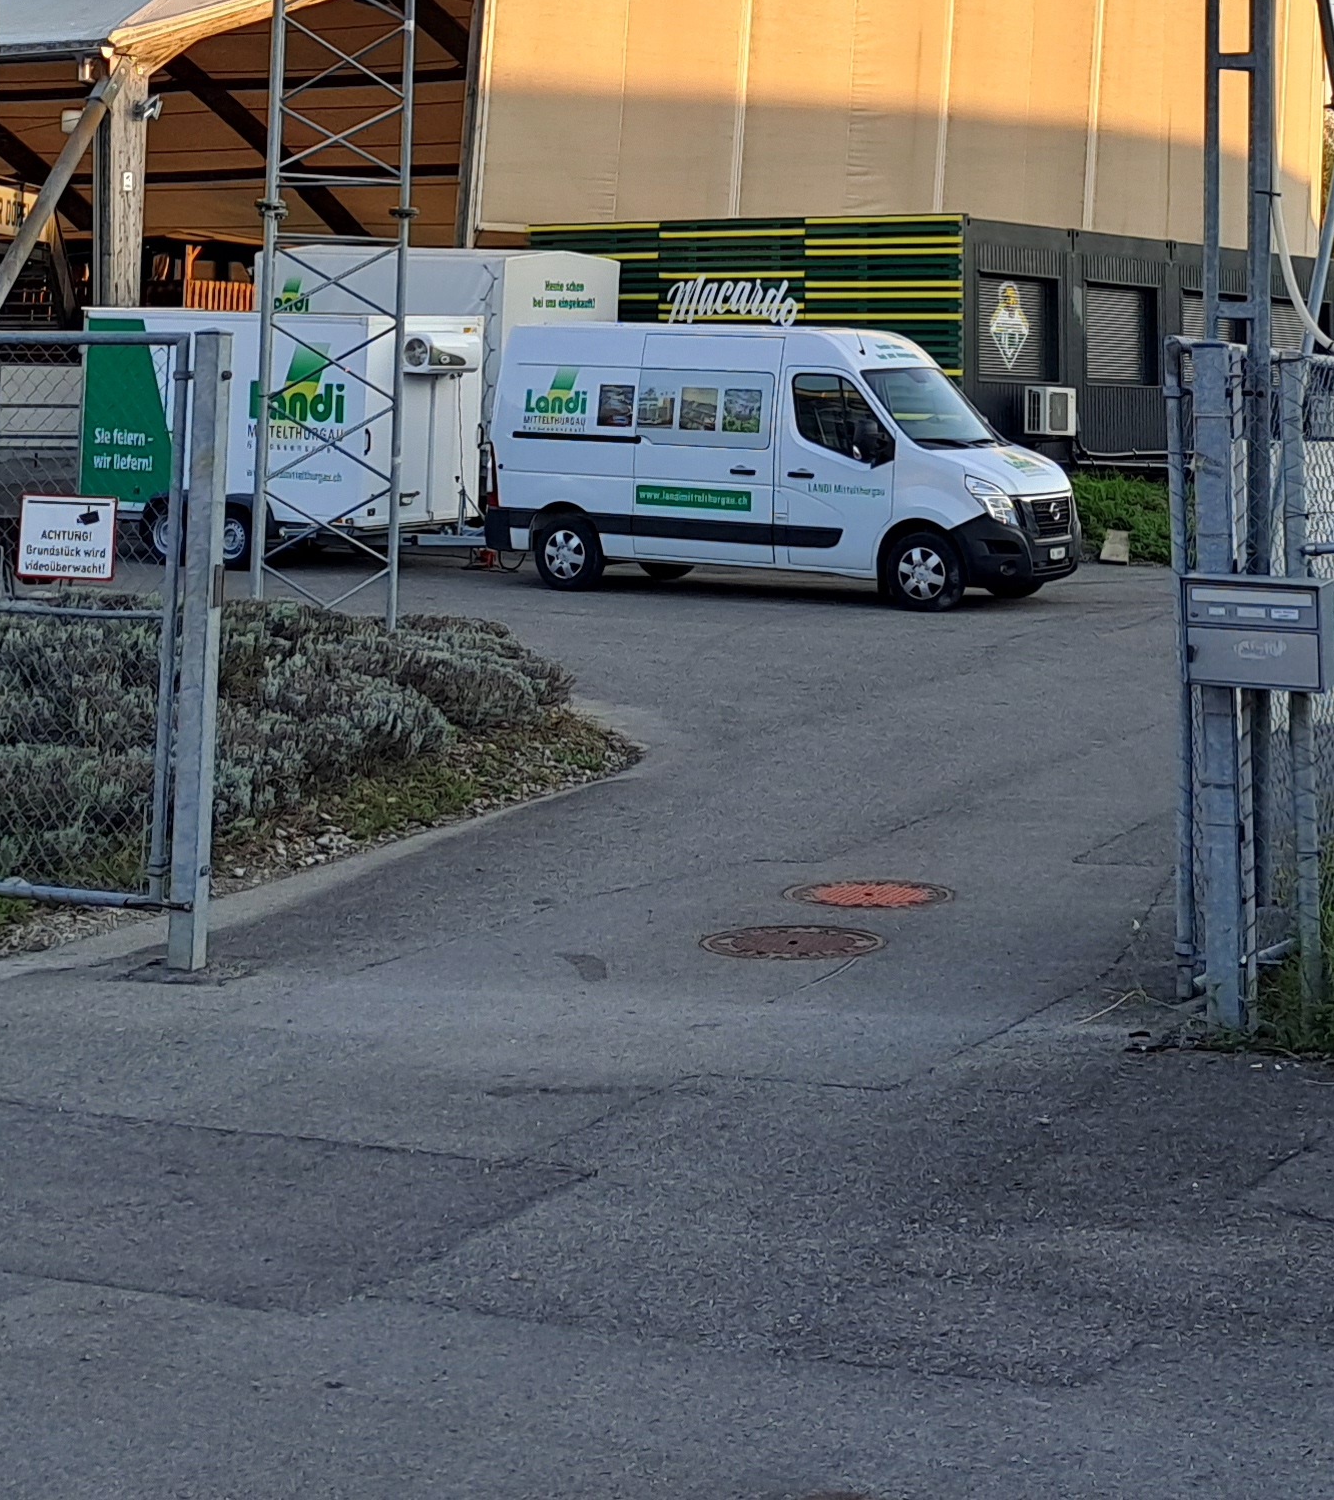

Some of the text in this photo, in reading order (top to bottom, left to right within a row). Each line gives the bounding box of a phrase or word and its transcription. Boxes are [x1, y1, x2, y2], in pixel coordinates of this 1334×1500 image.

[274, 293, 309, 312] andi
[667, 275, 798, 327] Macardo
[524, 389, 588, 415] Landi
[94, 427, 111, 444] Sie
[113, 427, 146, 447] feiern
[247, 424, 344, 442] MTELTHURGAU
[93, 452, 153, 472] wir liefern!
[808, 483, 831, 494] LANDI
[40, 529, 93, 542] ACHTUNG!
[26, 544, 107, 559] Grundstück wird
[24, 559, 106, 575] videoüberwacht!
